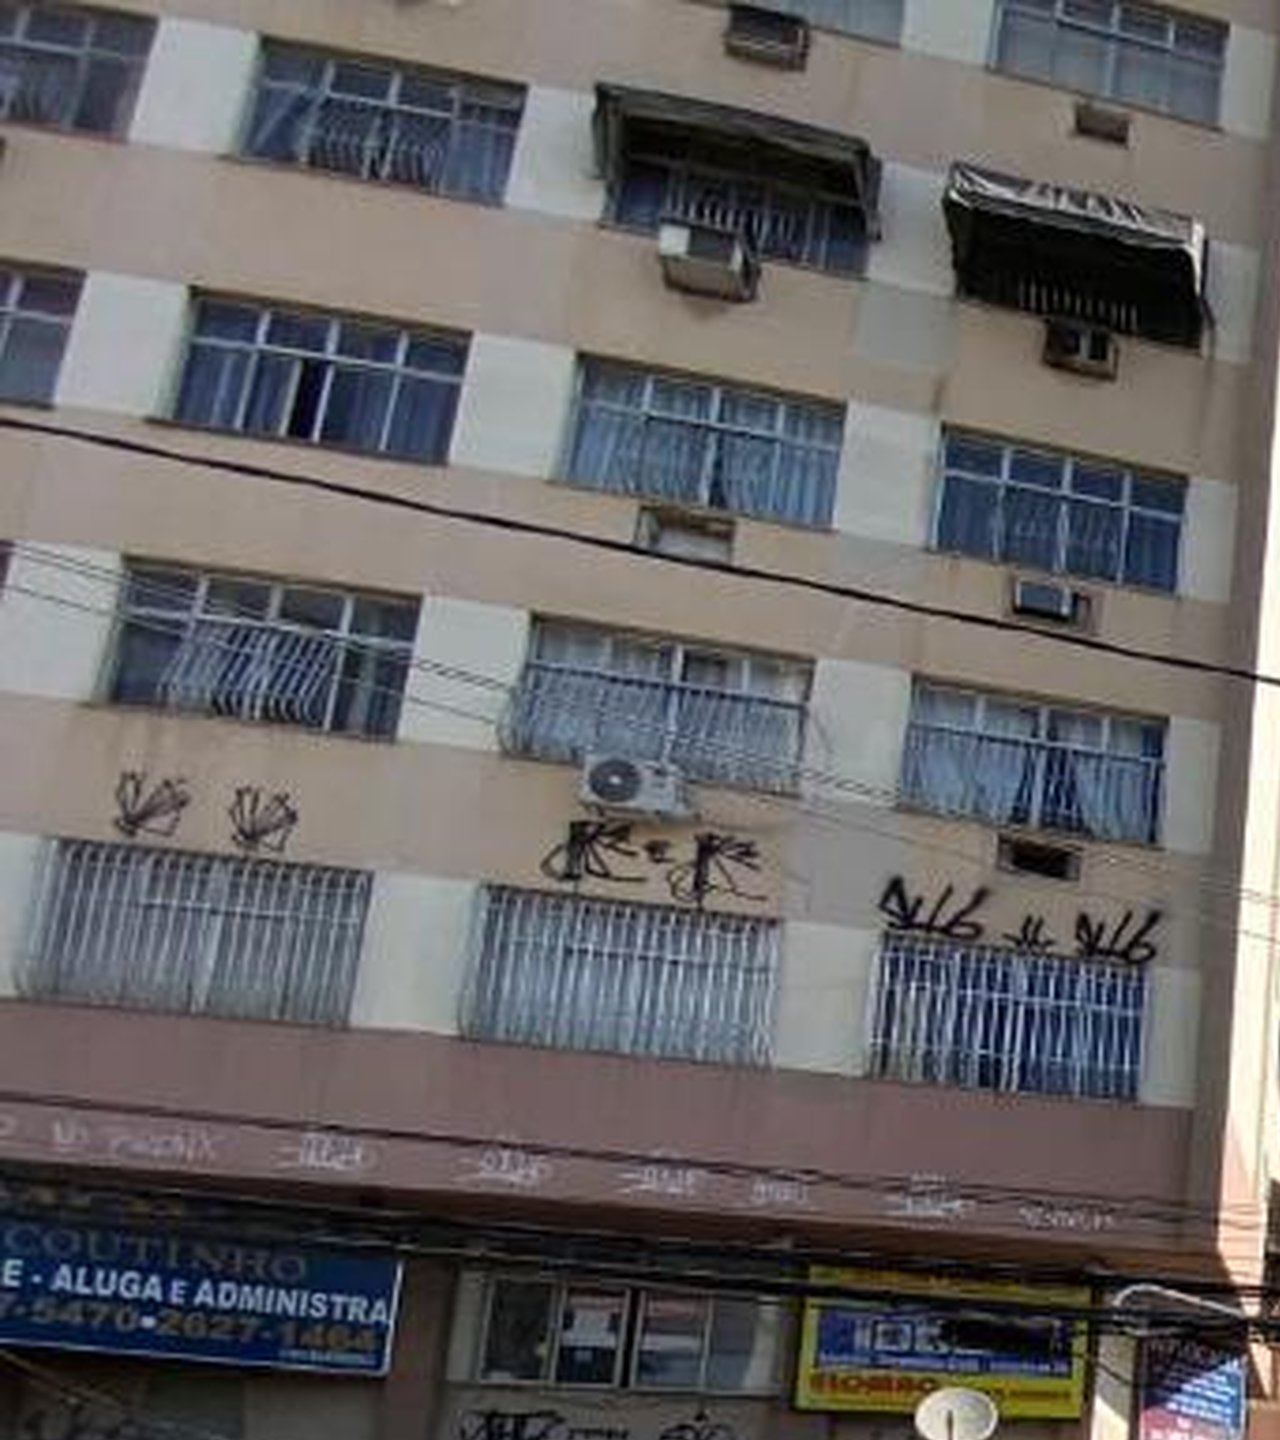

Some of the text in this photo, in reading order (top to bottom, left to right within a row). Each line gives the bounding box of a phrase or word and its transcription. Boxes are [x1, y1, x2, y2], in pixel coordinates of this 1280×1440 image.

[50, 1263, 163, 1303] ALUGA
[169, 1279, 190, 1305] E
[193, 1278, 390, 1324] ADMINISTRA
